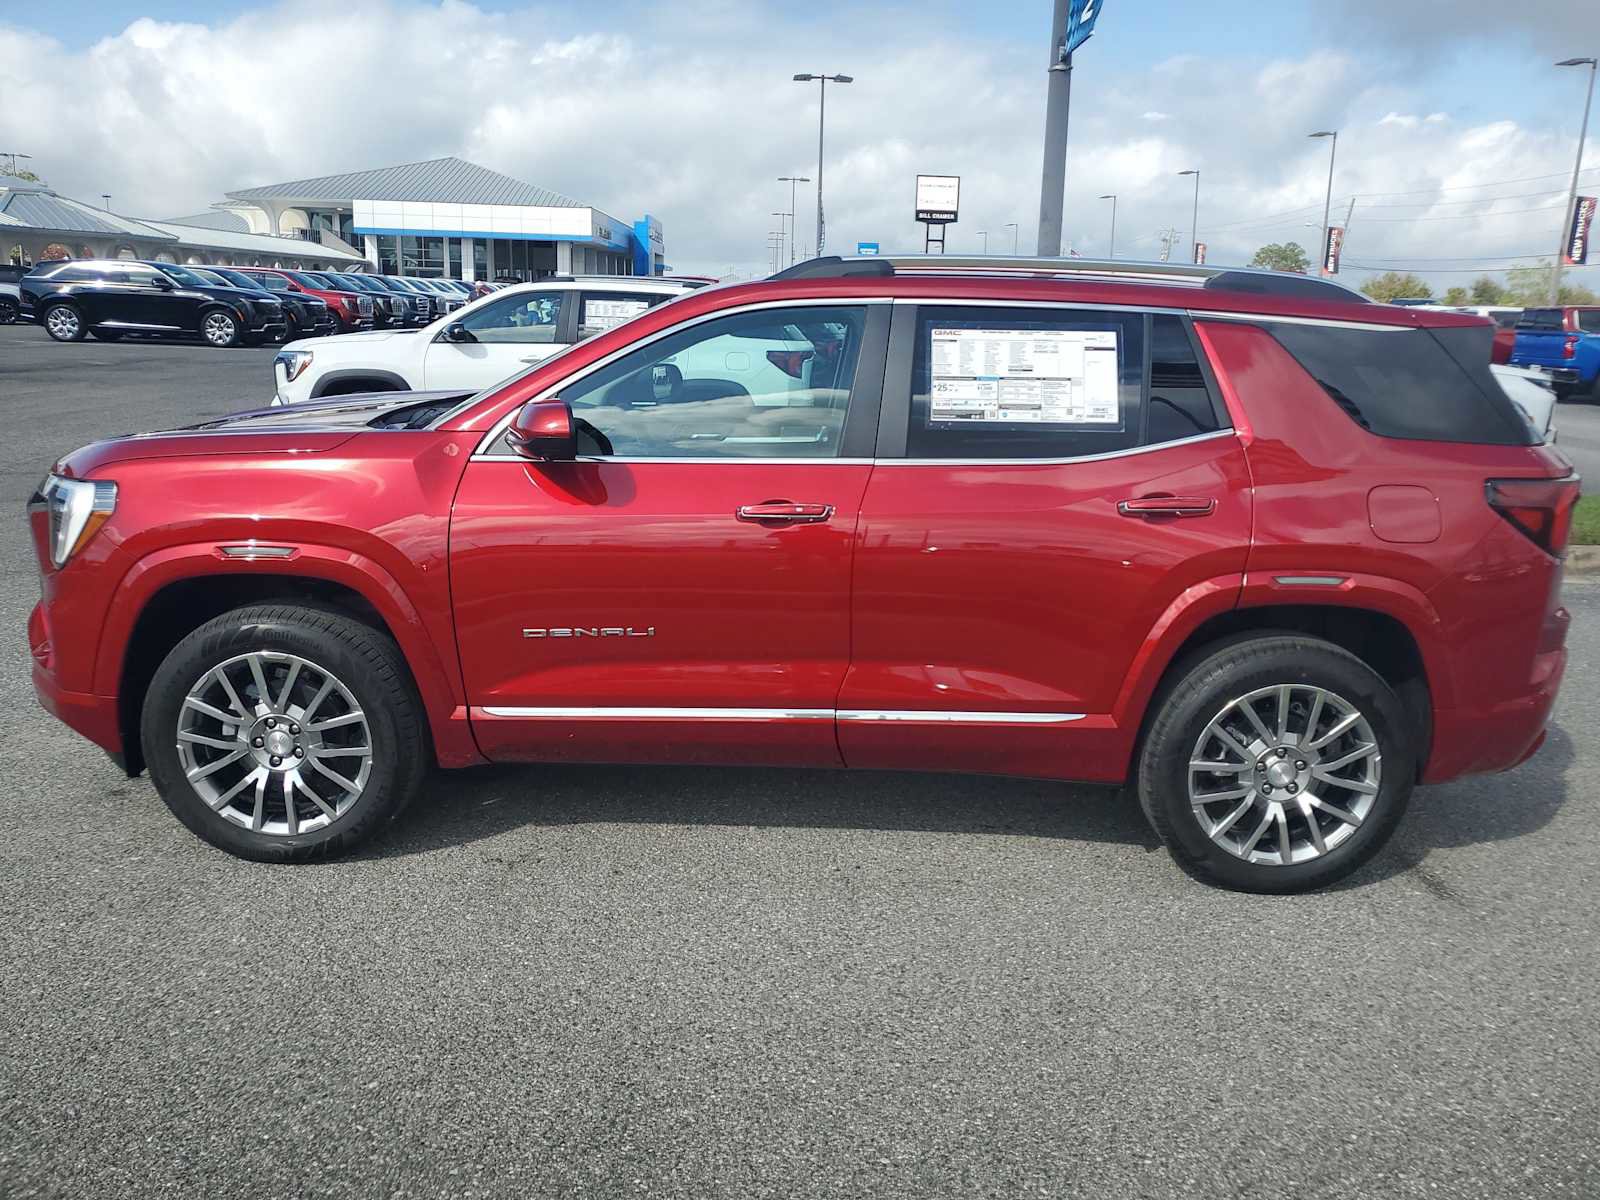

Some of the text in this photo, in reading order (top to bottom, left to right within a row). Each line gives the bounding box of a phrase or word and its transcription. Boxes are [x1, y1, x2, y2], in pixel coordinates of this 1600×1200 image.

[1571, 200, 1590, 261] NEW TRUCKS
[523, 627, 655, 638] DENALI
